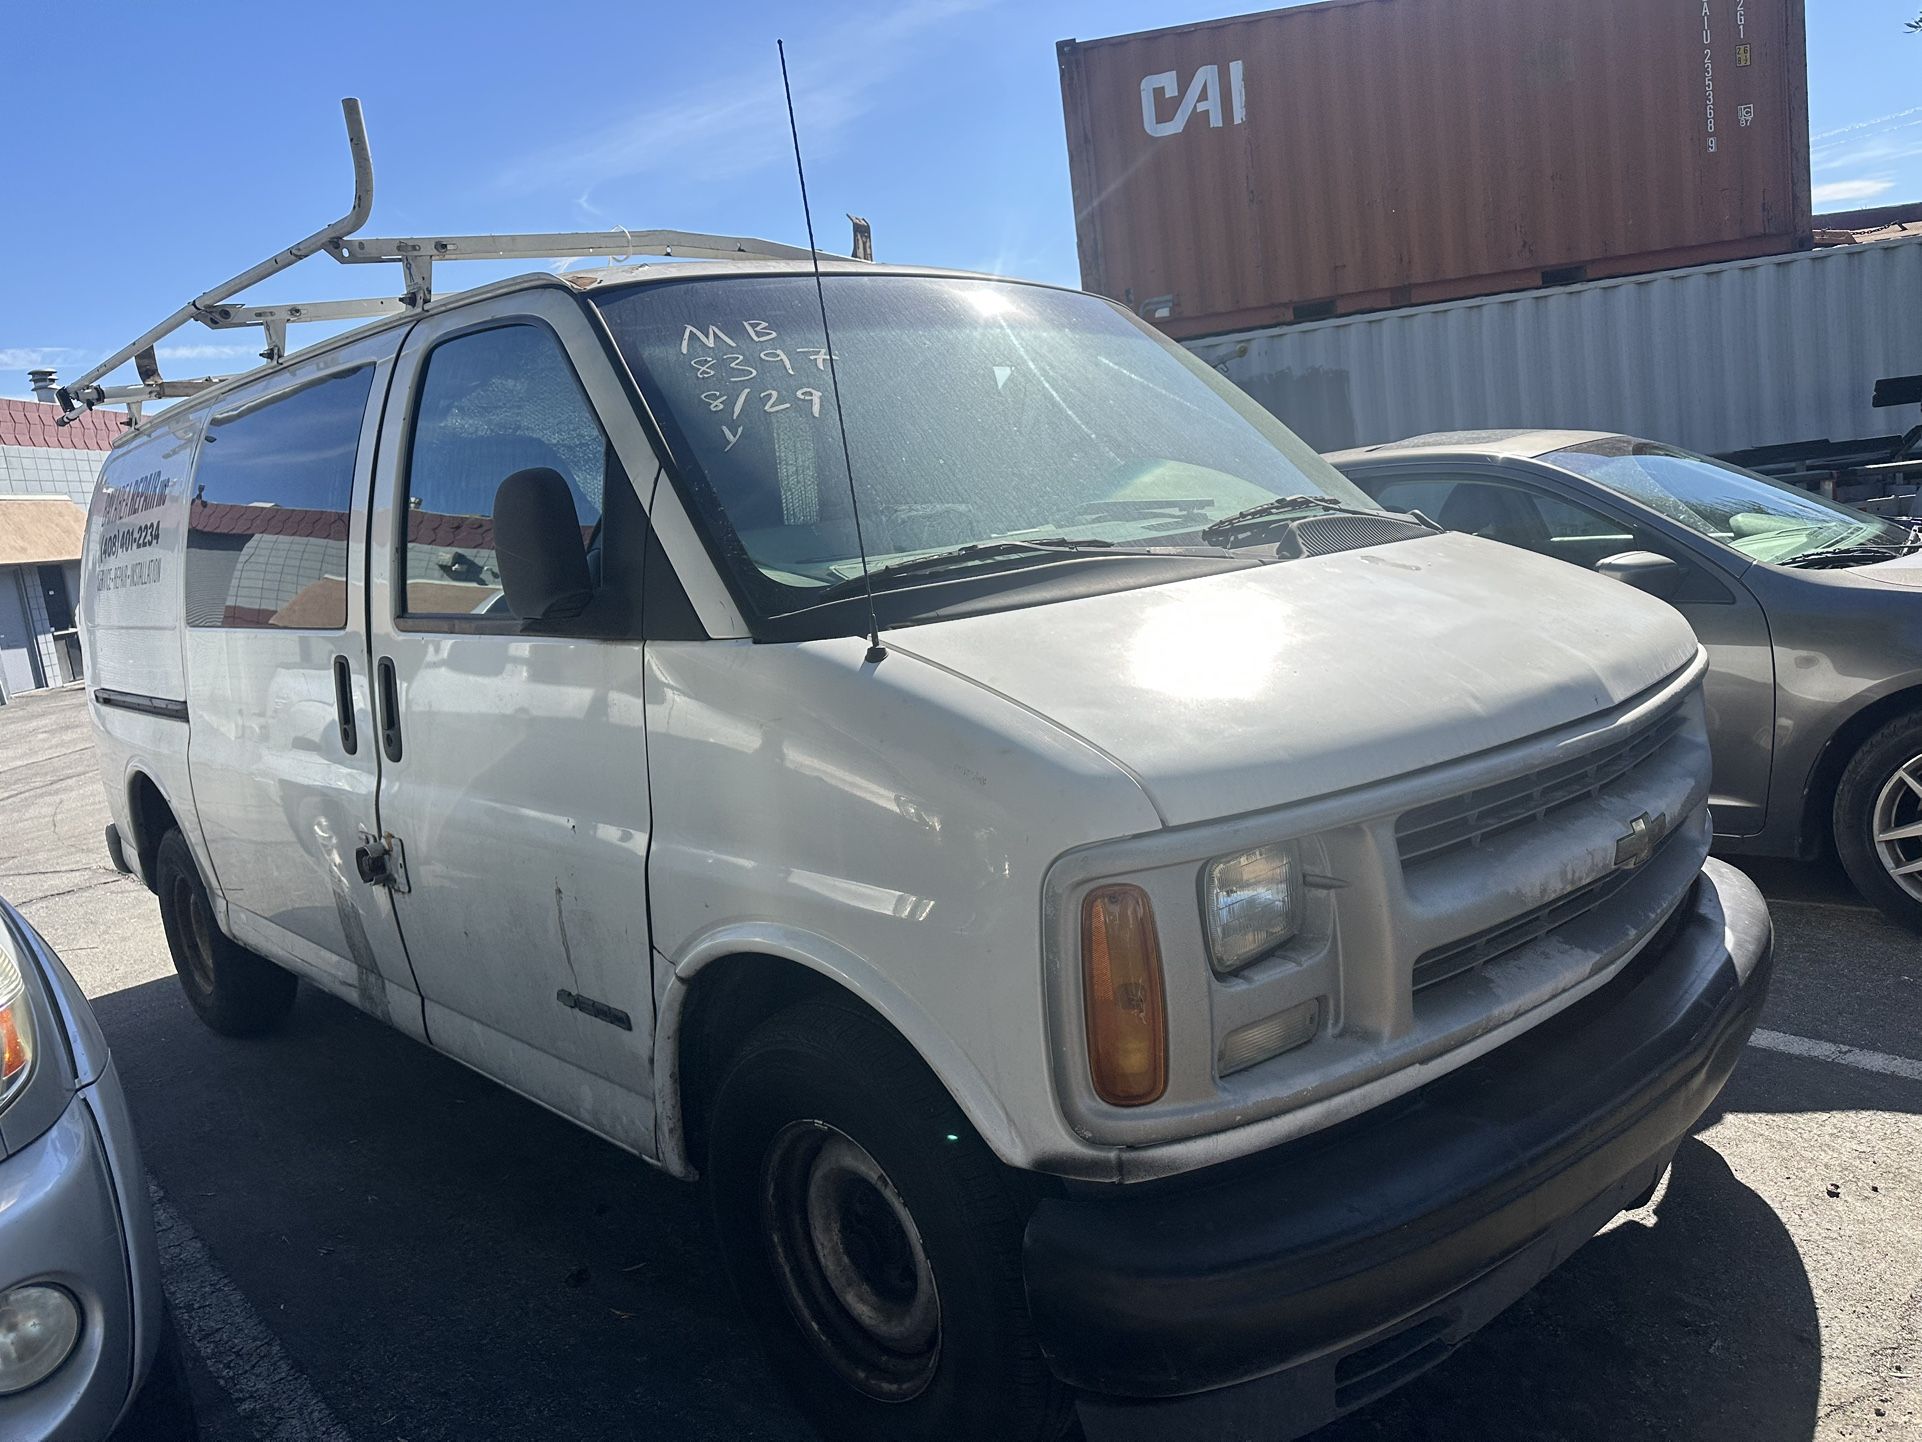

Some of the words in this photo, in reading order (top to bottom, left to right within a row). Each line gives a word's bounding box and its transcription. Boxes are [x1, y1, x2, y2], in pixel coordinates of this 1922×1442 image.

[1702, 0, 1711, 44] AIU
[1141, 60, 1246, 137] CAI
[1704, 49, 1714, 132] 235368
[1708, 137, 1716, 152] 9
[691, 348, 840, 381] 8397
[701, 387, 822, 418] 8/29
[127, 470, 162, 518] REPAIR
